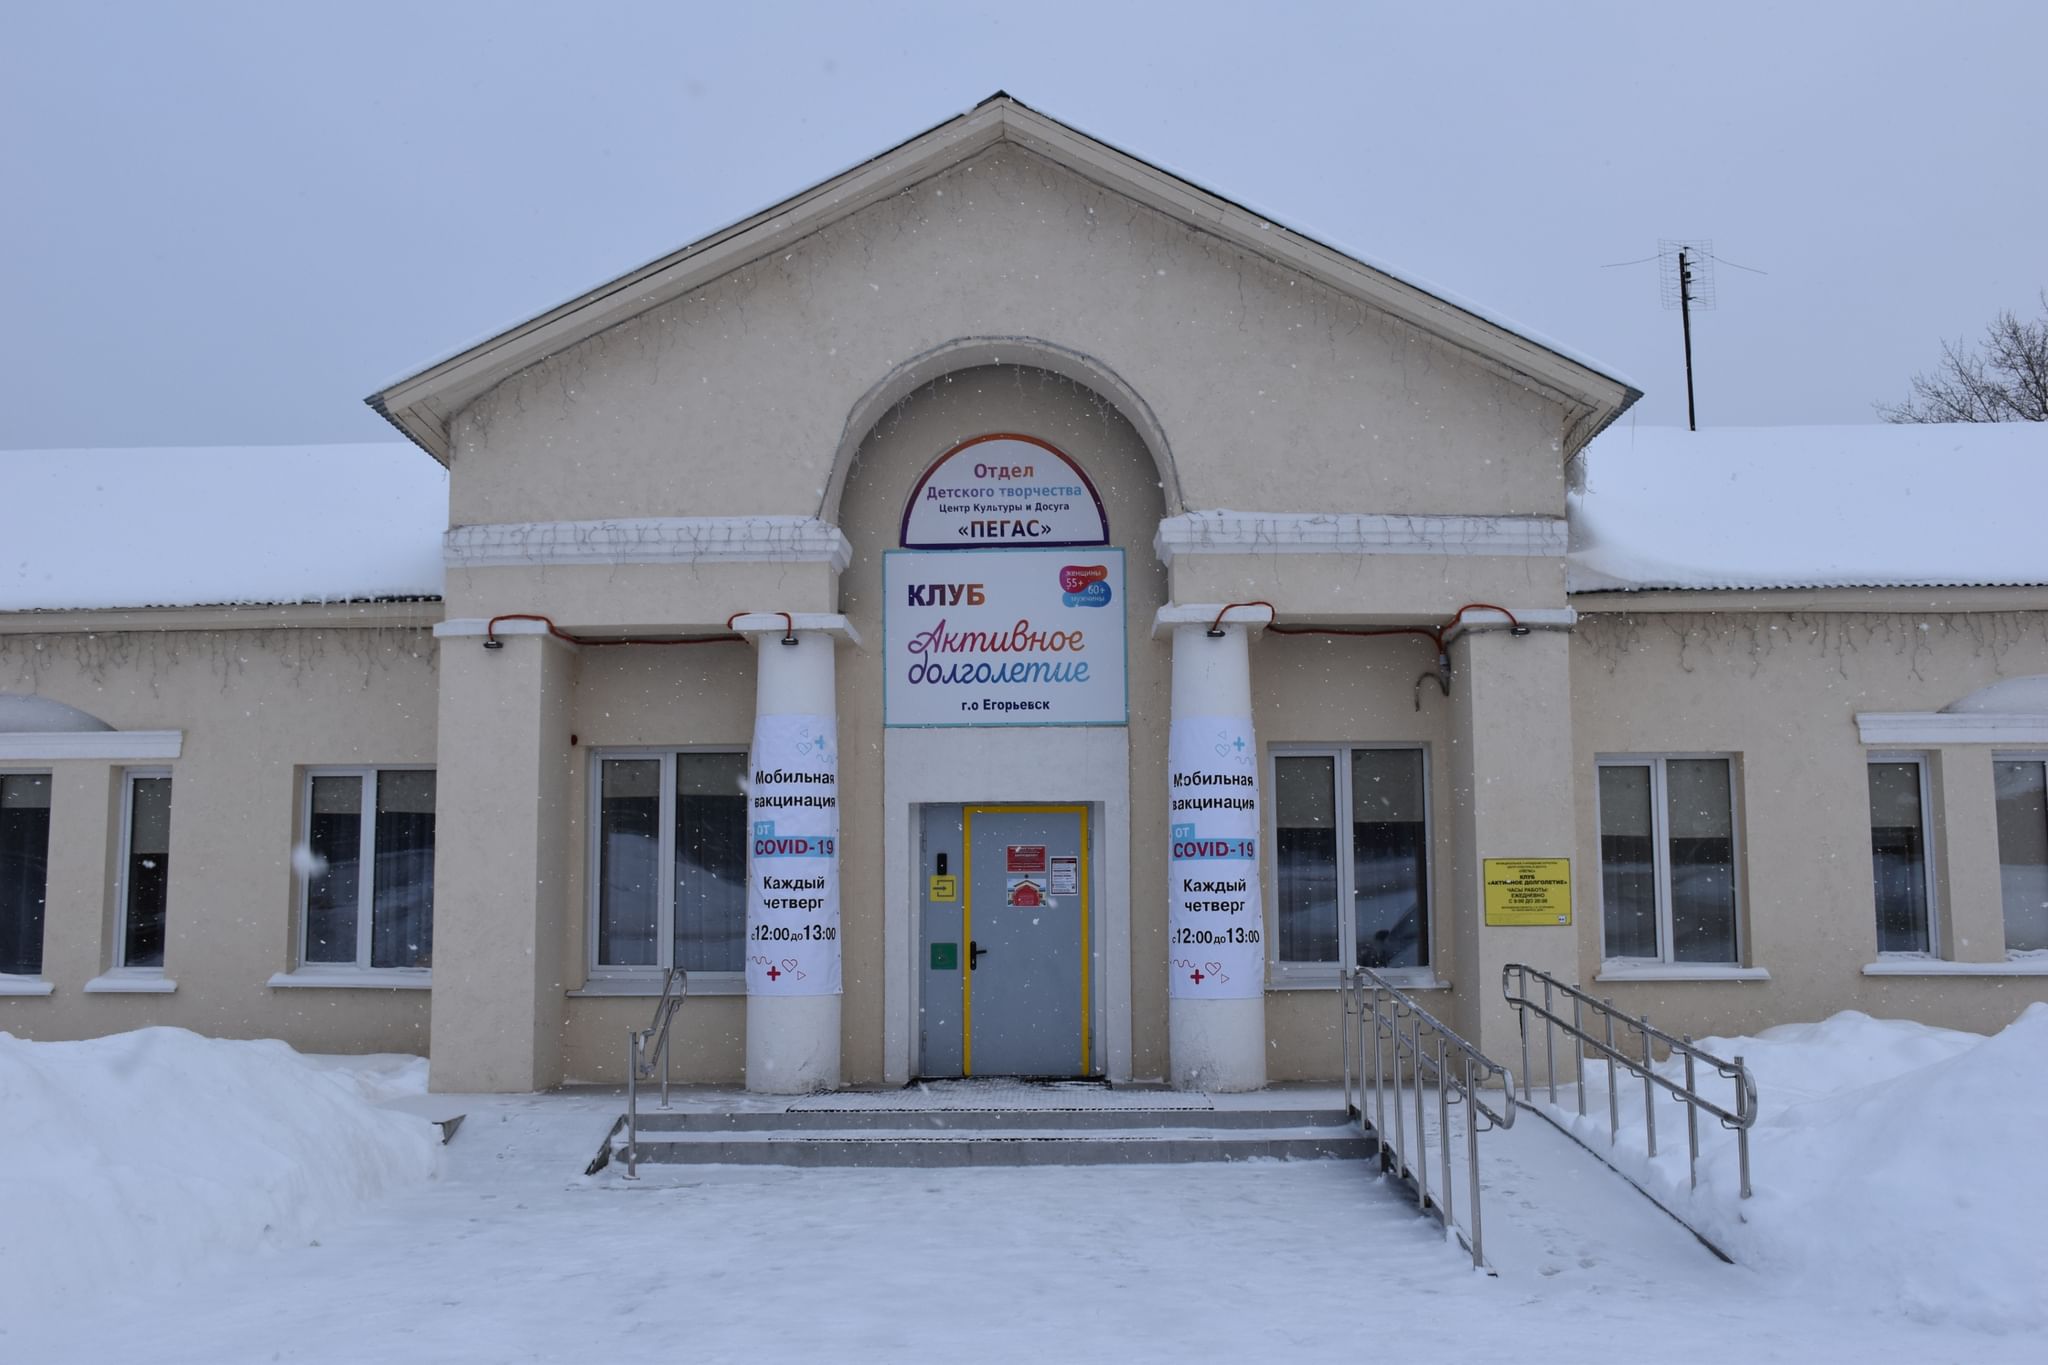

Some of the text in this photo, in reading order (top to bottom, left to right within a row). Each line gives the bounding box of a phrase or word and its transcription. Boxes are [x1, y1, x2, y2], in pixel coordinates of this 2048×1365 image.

[974, 463, 1034, 480] Отдел
[926, 485, 1082, 500] Детского творчества
[939, 503, 971, 514] Центр
[973, 502, 1023, 513] Культуры
[1034, 502, 1070, 512] Досуга
[958, 519, 1052, 538] «ПЕГАС»
[1066, 577, 1084, 588] 55+
[1088, 584, 1105, 595] 60+
[908, 584, 985, 607] КЛУБ
[907, 618, 1085, 654] Активное
[908, 650, 1090, 684] долголетие
[961, 699, 1050, 712] г.о Егорьевск
[755, 769, 834, 784] Мобильная
[1173, 771, 1254, 787] Мобильная
[754, 795, 836, 809] вакцинация
[1172, 797, 1255, 811] вакцинация
[755, 839, 834, 855] COVID-19
[1173, 841, 1254, 858] COVID-19
[763, 875, 825, 891] Каждый
[1183, 878, 1247, 894] Каждый
[763, 899, 825, 912] четверг
[1184, 901, 1246, 915] четверг
